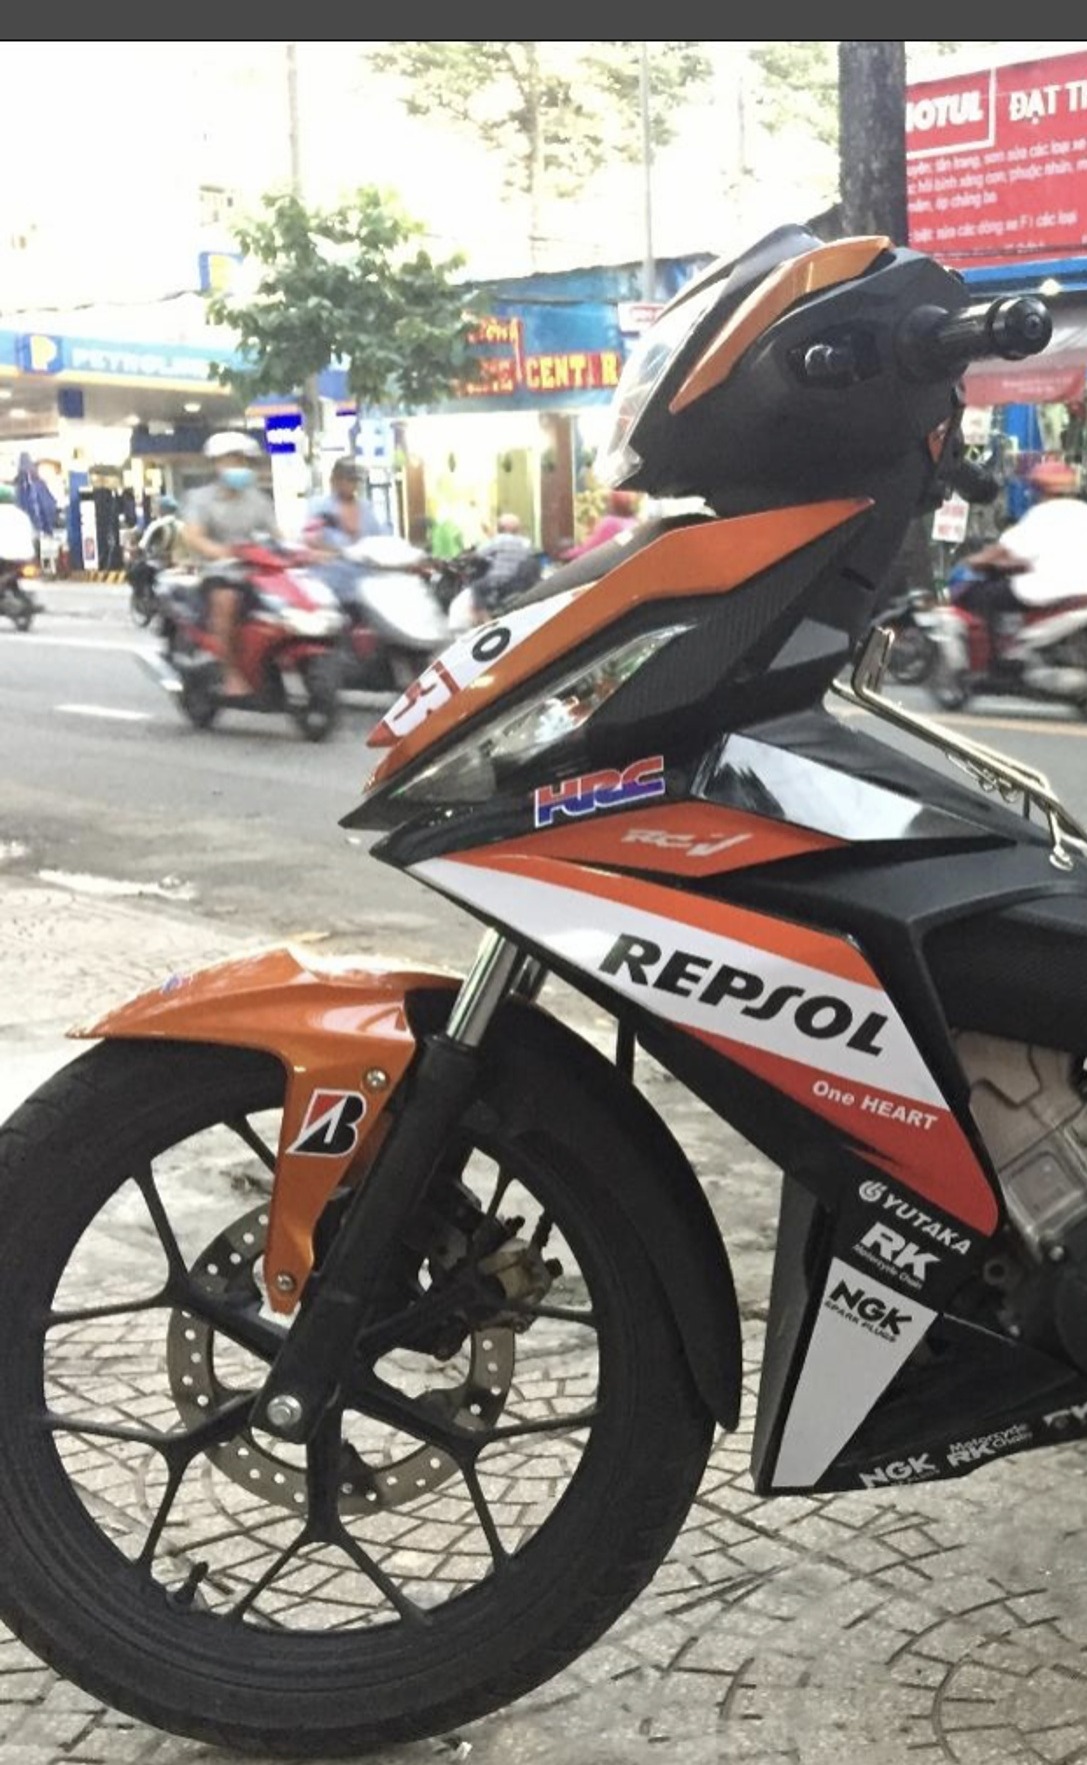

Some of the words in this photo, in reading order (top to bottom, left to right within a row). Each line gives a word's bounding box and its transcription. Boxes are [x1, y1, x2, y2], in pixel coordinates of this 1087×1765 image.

[1009, 84, 1061, 125] ĐẠT
[534, 754, 666, 829] HRC
[598, 932, 890, 1058] REPSOL
[811, 1079, 856, 1108] One
[860, 1094, 939, 1132] HEART
[860, 1220, 942, 1283] RK
[882, 1193, 972, 1256] YUTAKA
[828, 1278, 912, 1336] NGK
[858, 1452, 938, 1489] NGK
